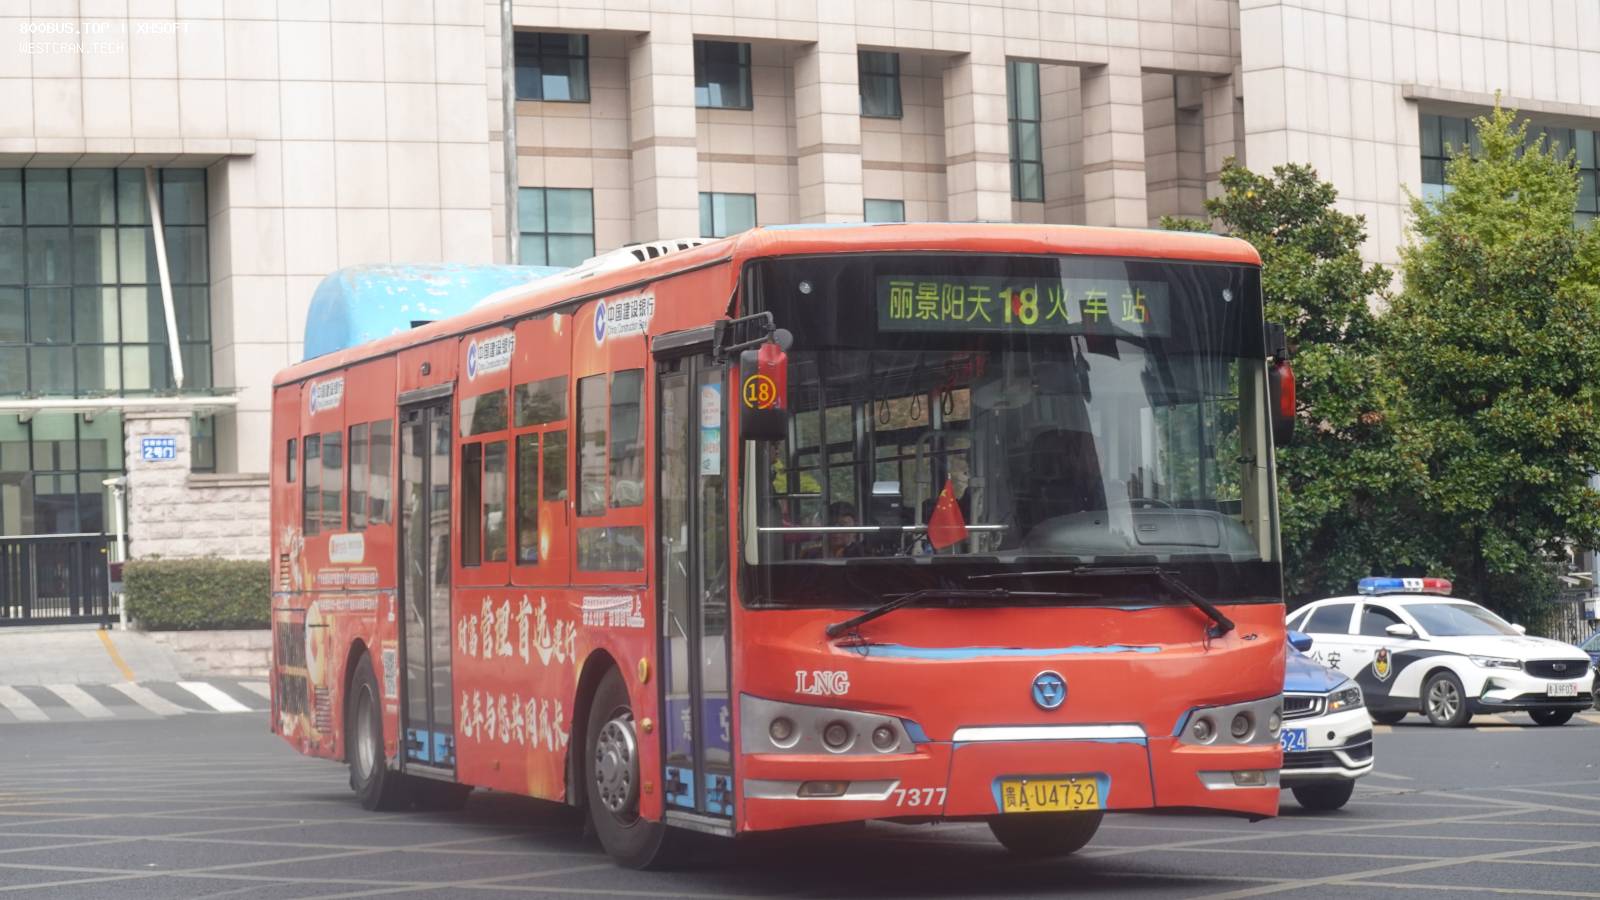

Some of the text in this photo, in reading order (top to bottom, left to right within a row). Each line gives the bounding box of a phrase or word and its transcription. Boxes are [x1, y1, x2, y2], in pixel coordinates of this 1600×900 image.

[608, 297, 654, 321] 中国建设银行
[888, 281, 1147, 325] 丽景阳天 18 火车站
[748, 383, 769, 402] 18
[1311, 650, 1341, 670] 公安
[795, 670, 851, 696] LNG
[1280, 731, 1305, 749] 624
[895, 787, 947, 807] 7377
